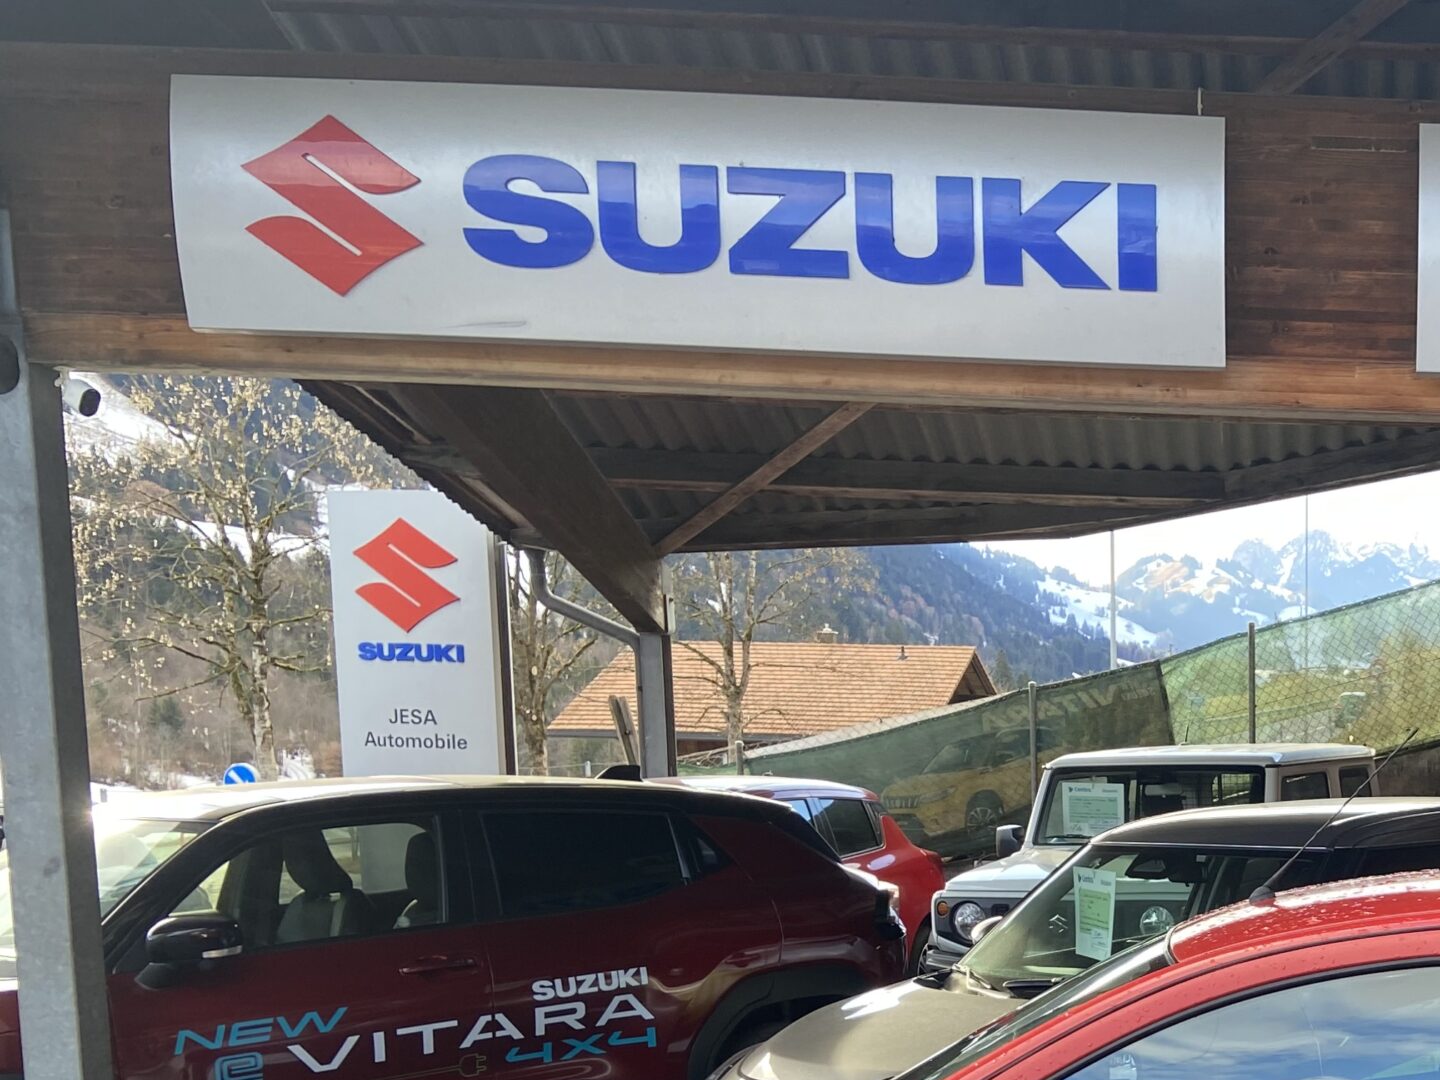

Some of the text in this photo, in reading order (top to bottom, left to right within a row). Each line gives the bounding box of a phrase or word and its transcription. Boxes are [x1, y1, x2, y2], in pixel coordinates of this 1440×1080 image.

[462, 154, 1158, 292] SUZUKI
[358, 642, 466, 663] SUZUKI
[389, 708, 438, 725] JESA
[364, 731, 468, 751] Automobile
[532, 966, 649, 1001] SUZUKI
[174, 1006, 349, 1056] NEW
[287, 993, 656, 1073] VITARA
